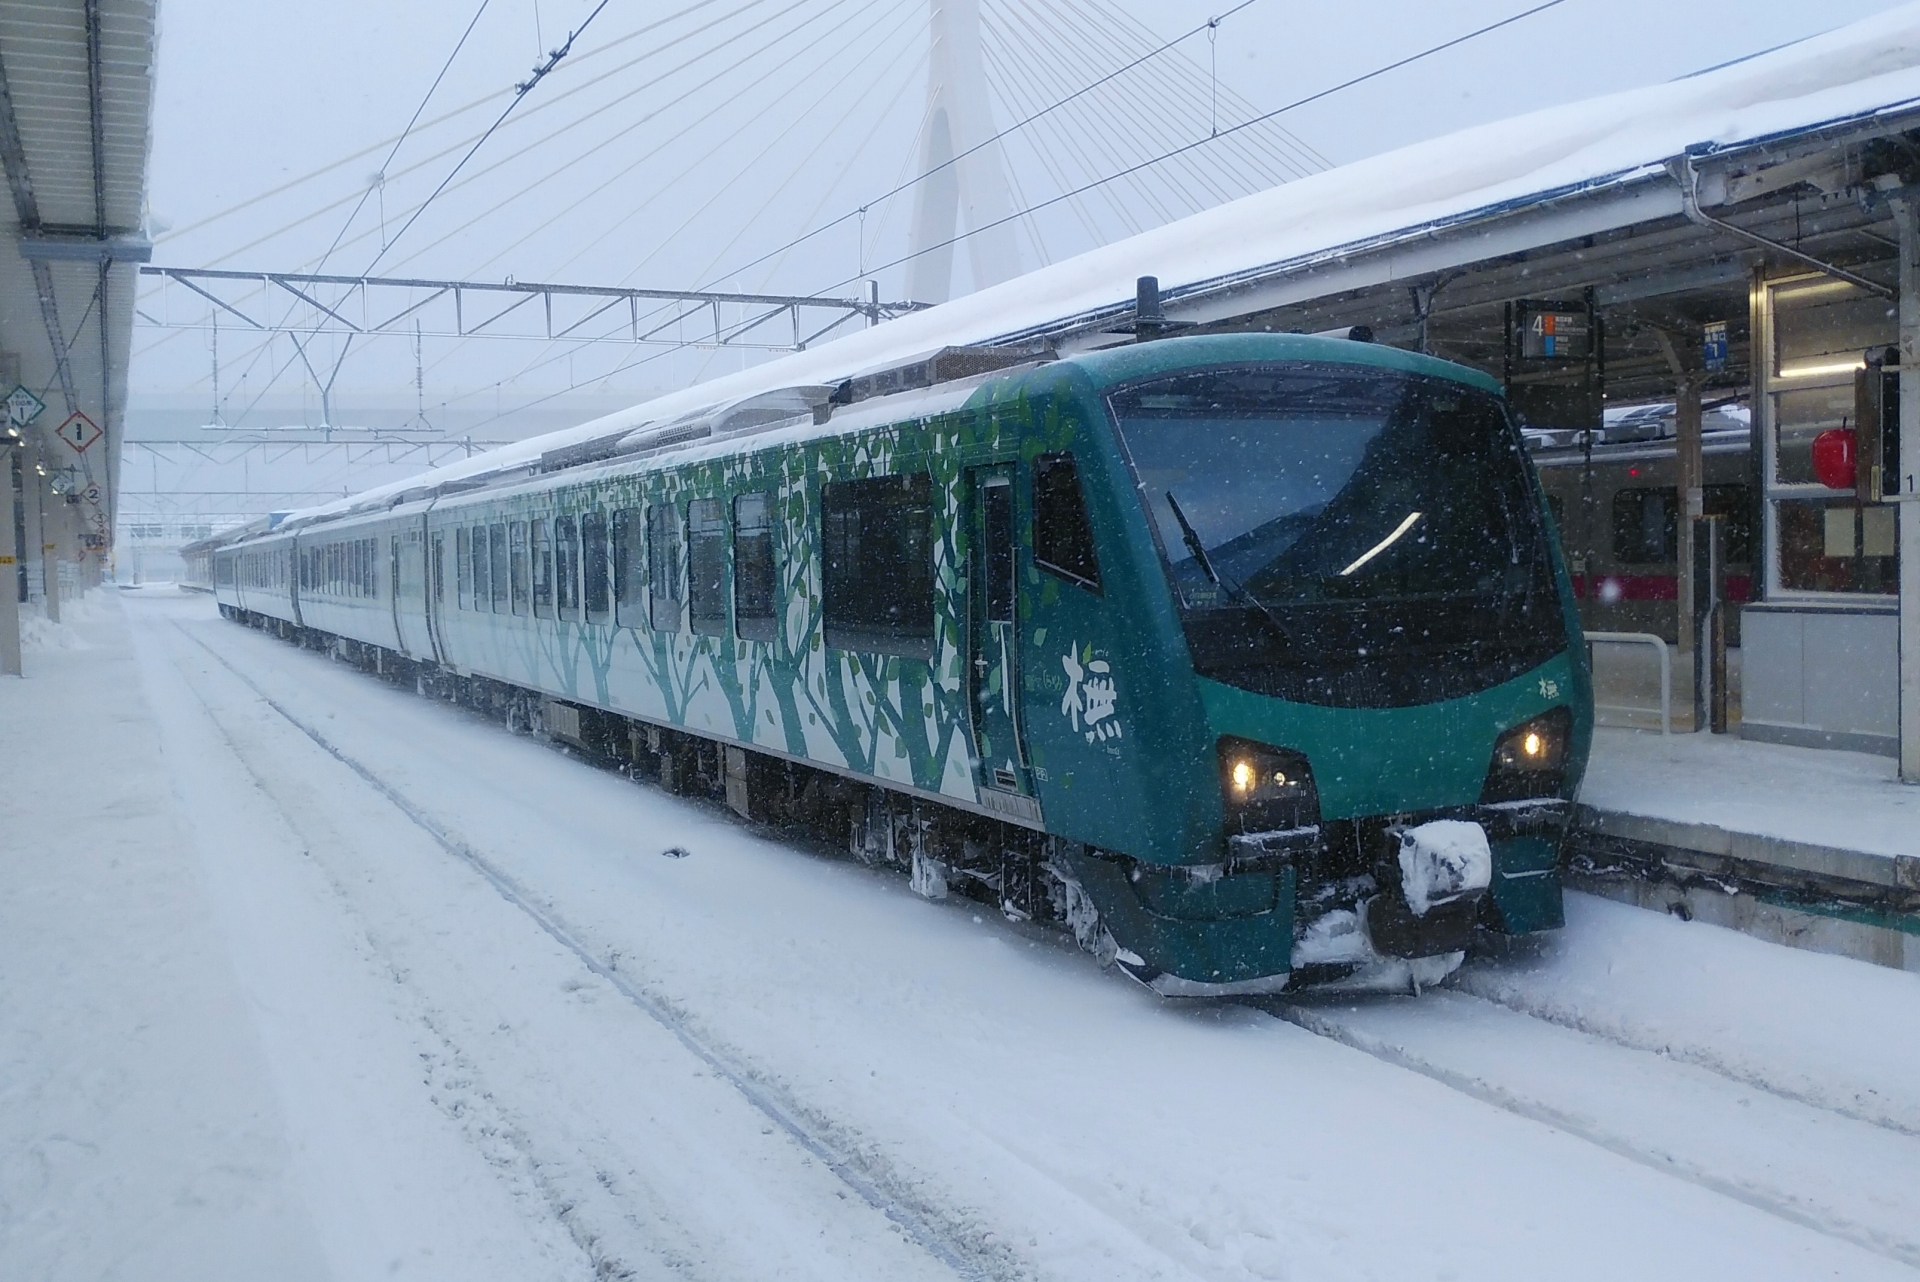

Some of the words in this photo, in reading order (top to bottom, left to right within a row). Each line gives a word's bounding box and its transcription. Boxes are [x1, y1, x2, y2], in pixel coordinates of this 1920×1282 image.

[1532, 315, 1544, 337] 4
[20, 407, 24, 420] 1
[76, 423, 82, 441] 1
[1906, 473, 1914, 493] 1
[88, 489, 99, 499] 2
[97, 513, 104, 524] 3
